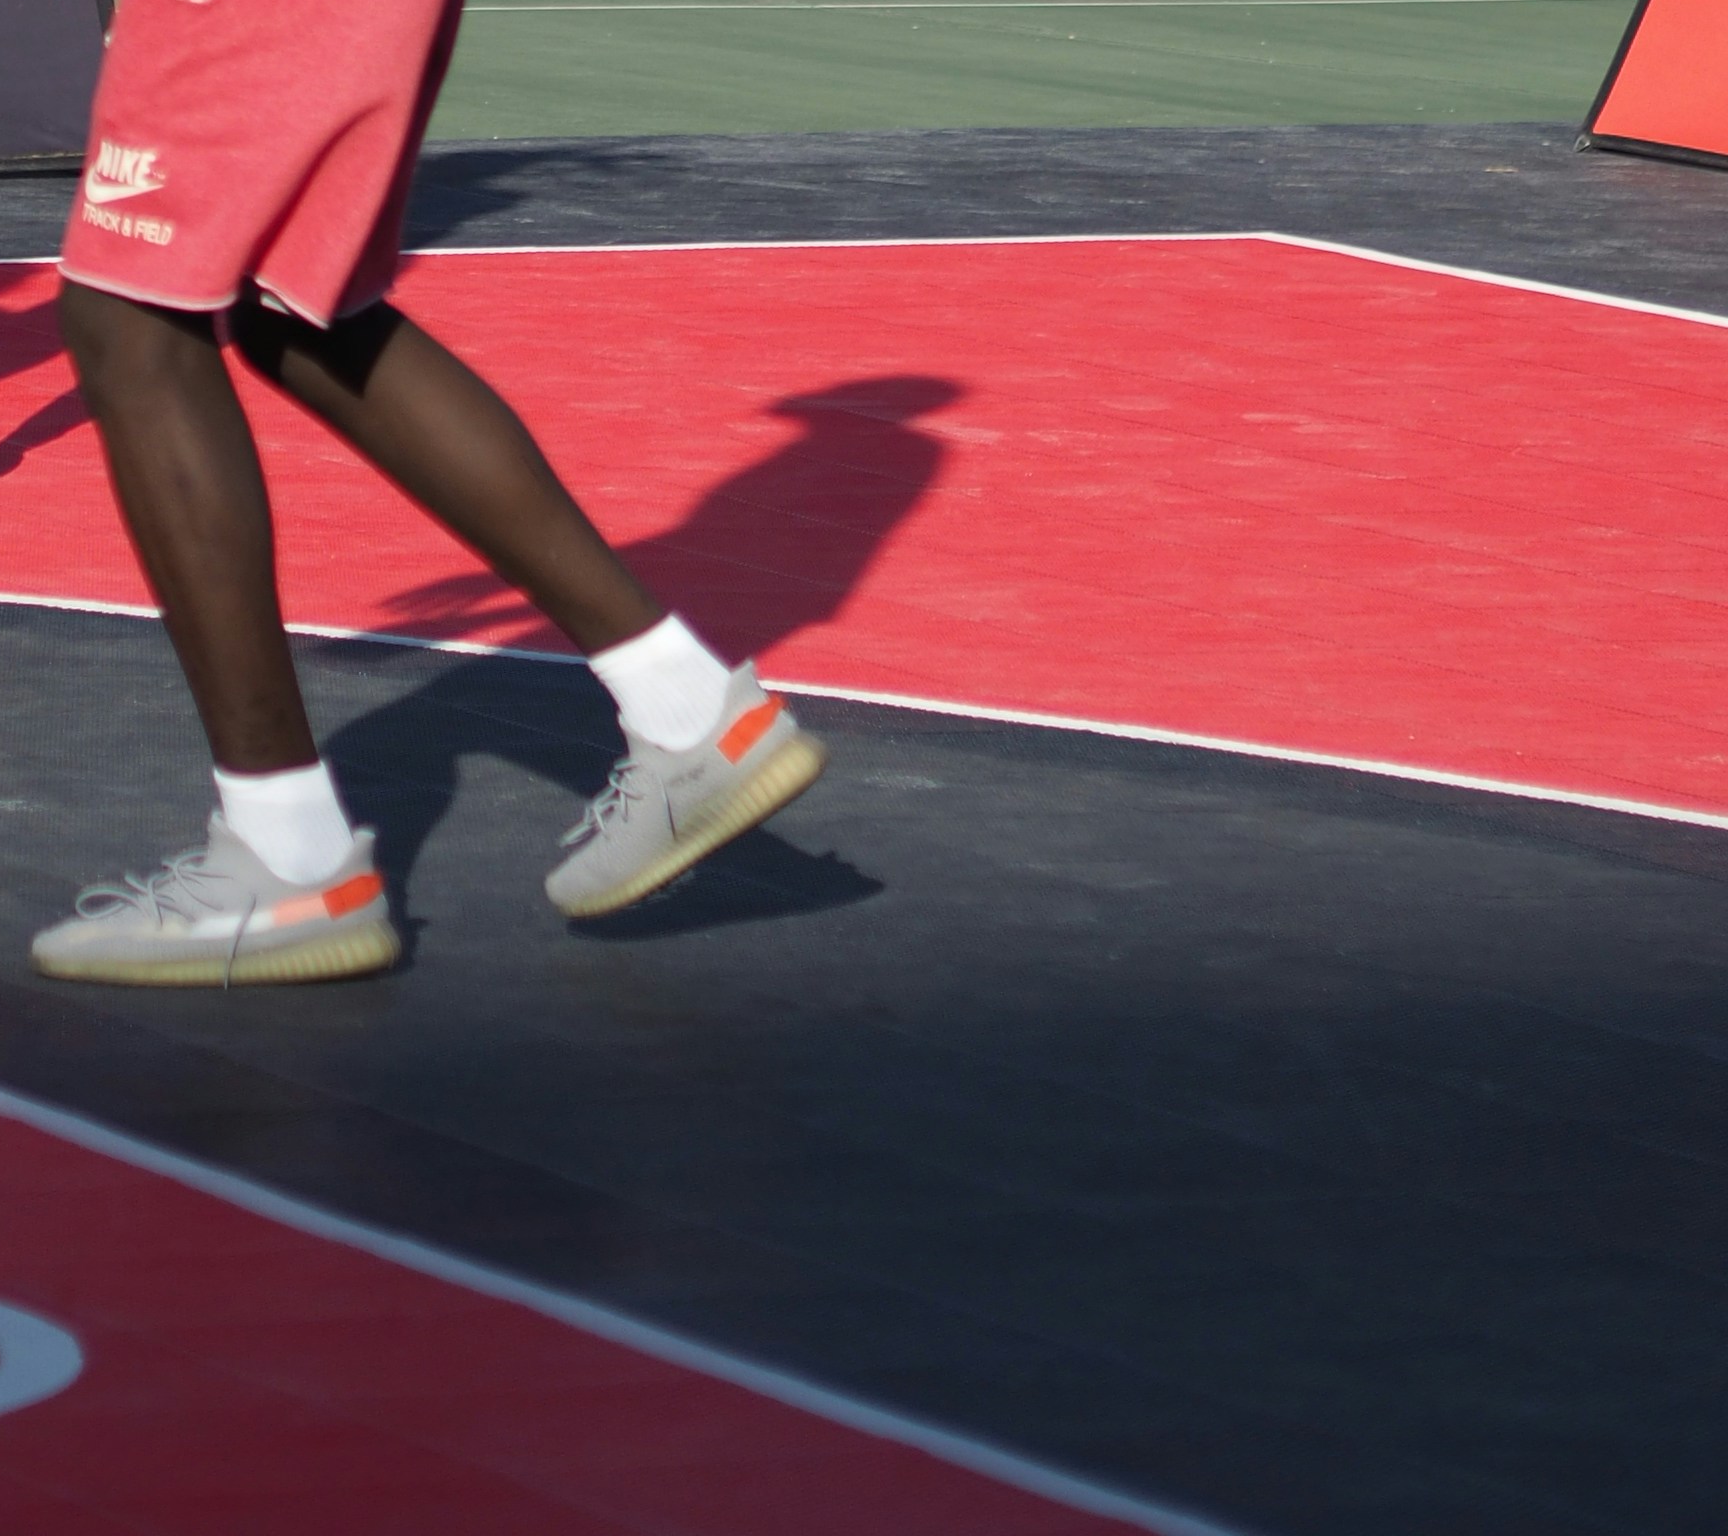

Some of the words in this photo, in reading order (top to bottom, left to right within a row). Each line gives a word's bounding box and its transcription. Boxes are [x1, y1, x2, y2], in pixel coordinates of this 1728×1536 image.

[97, 141, 156, 188] NIKE
[82, 202, 121, 235] TRACK
[121, 216, 133, 238] &
[134, 219, 173, 246] FIELD
